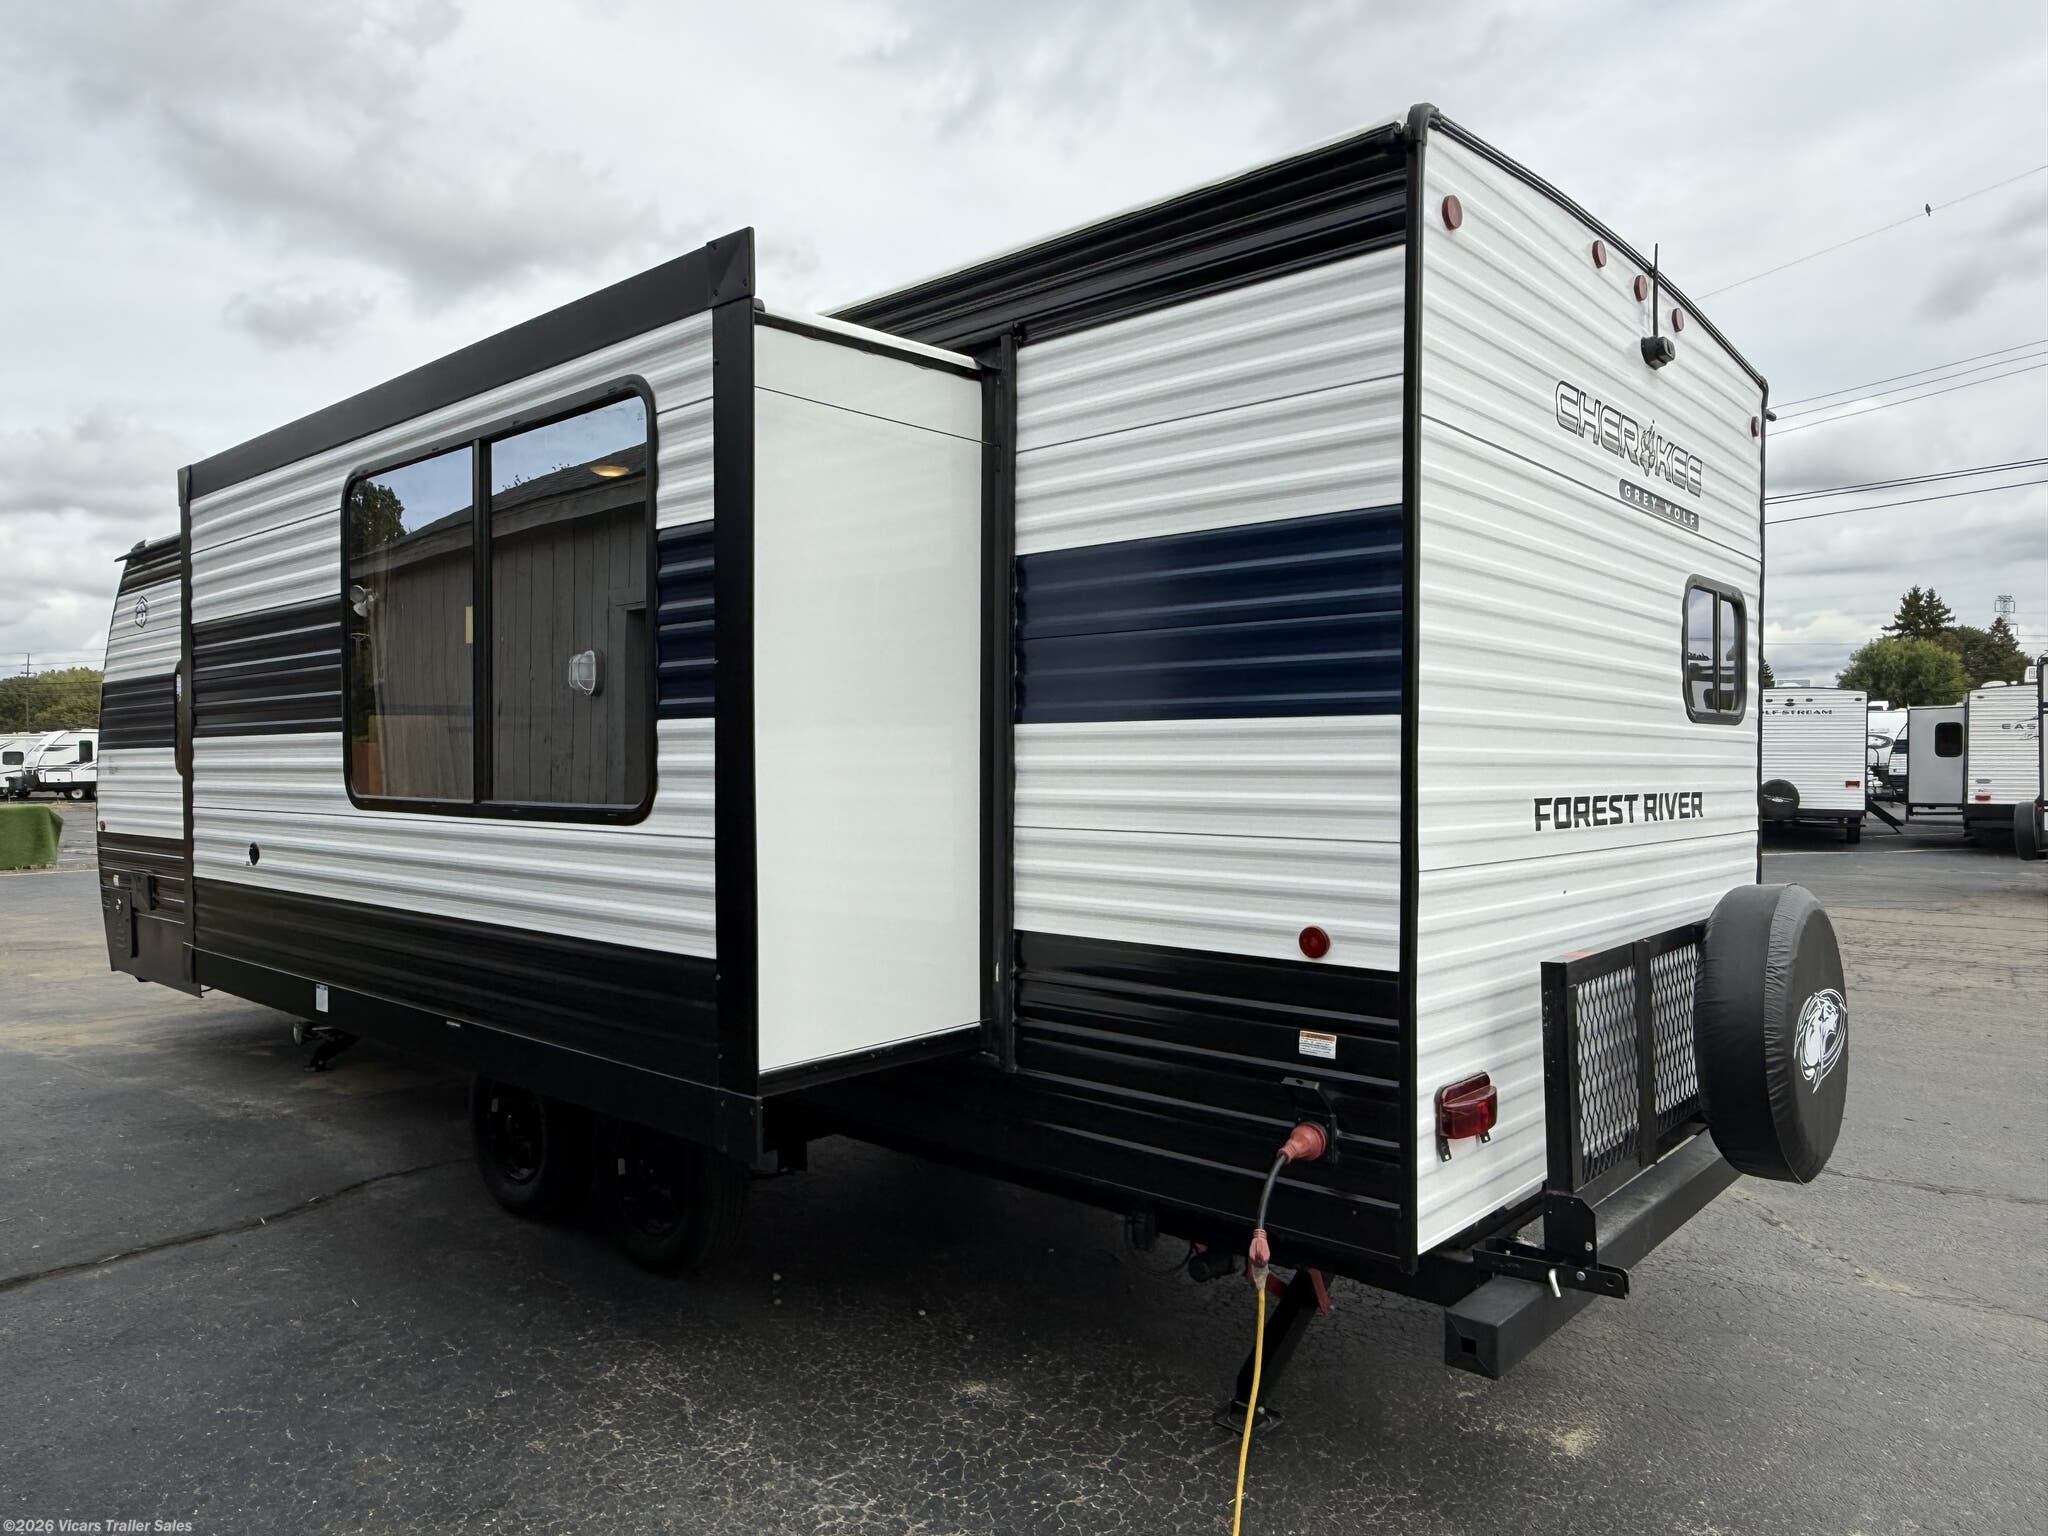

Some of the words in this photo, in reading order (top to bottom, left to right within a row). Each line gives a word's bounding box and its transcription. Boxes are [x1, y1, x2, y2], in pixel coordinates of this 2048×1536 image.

[1555, 380, 1703, 498] CHEROKEE
[1624, 484, 1658, 510] GREY
[1664, 501, 1696, 526] WOLF
[1534, 794, 1639, 831] FOREST
[1643, 791, 1704, 822] RIVER
